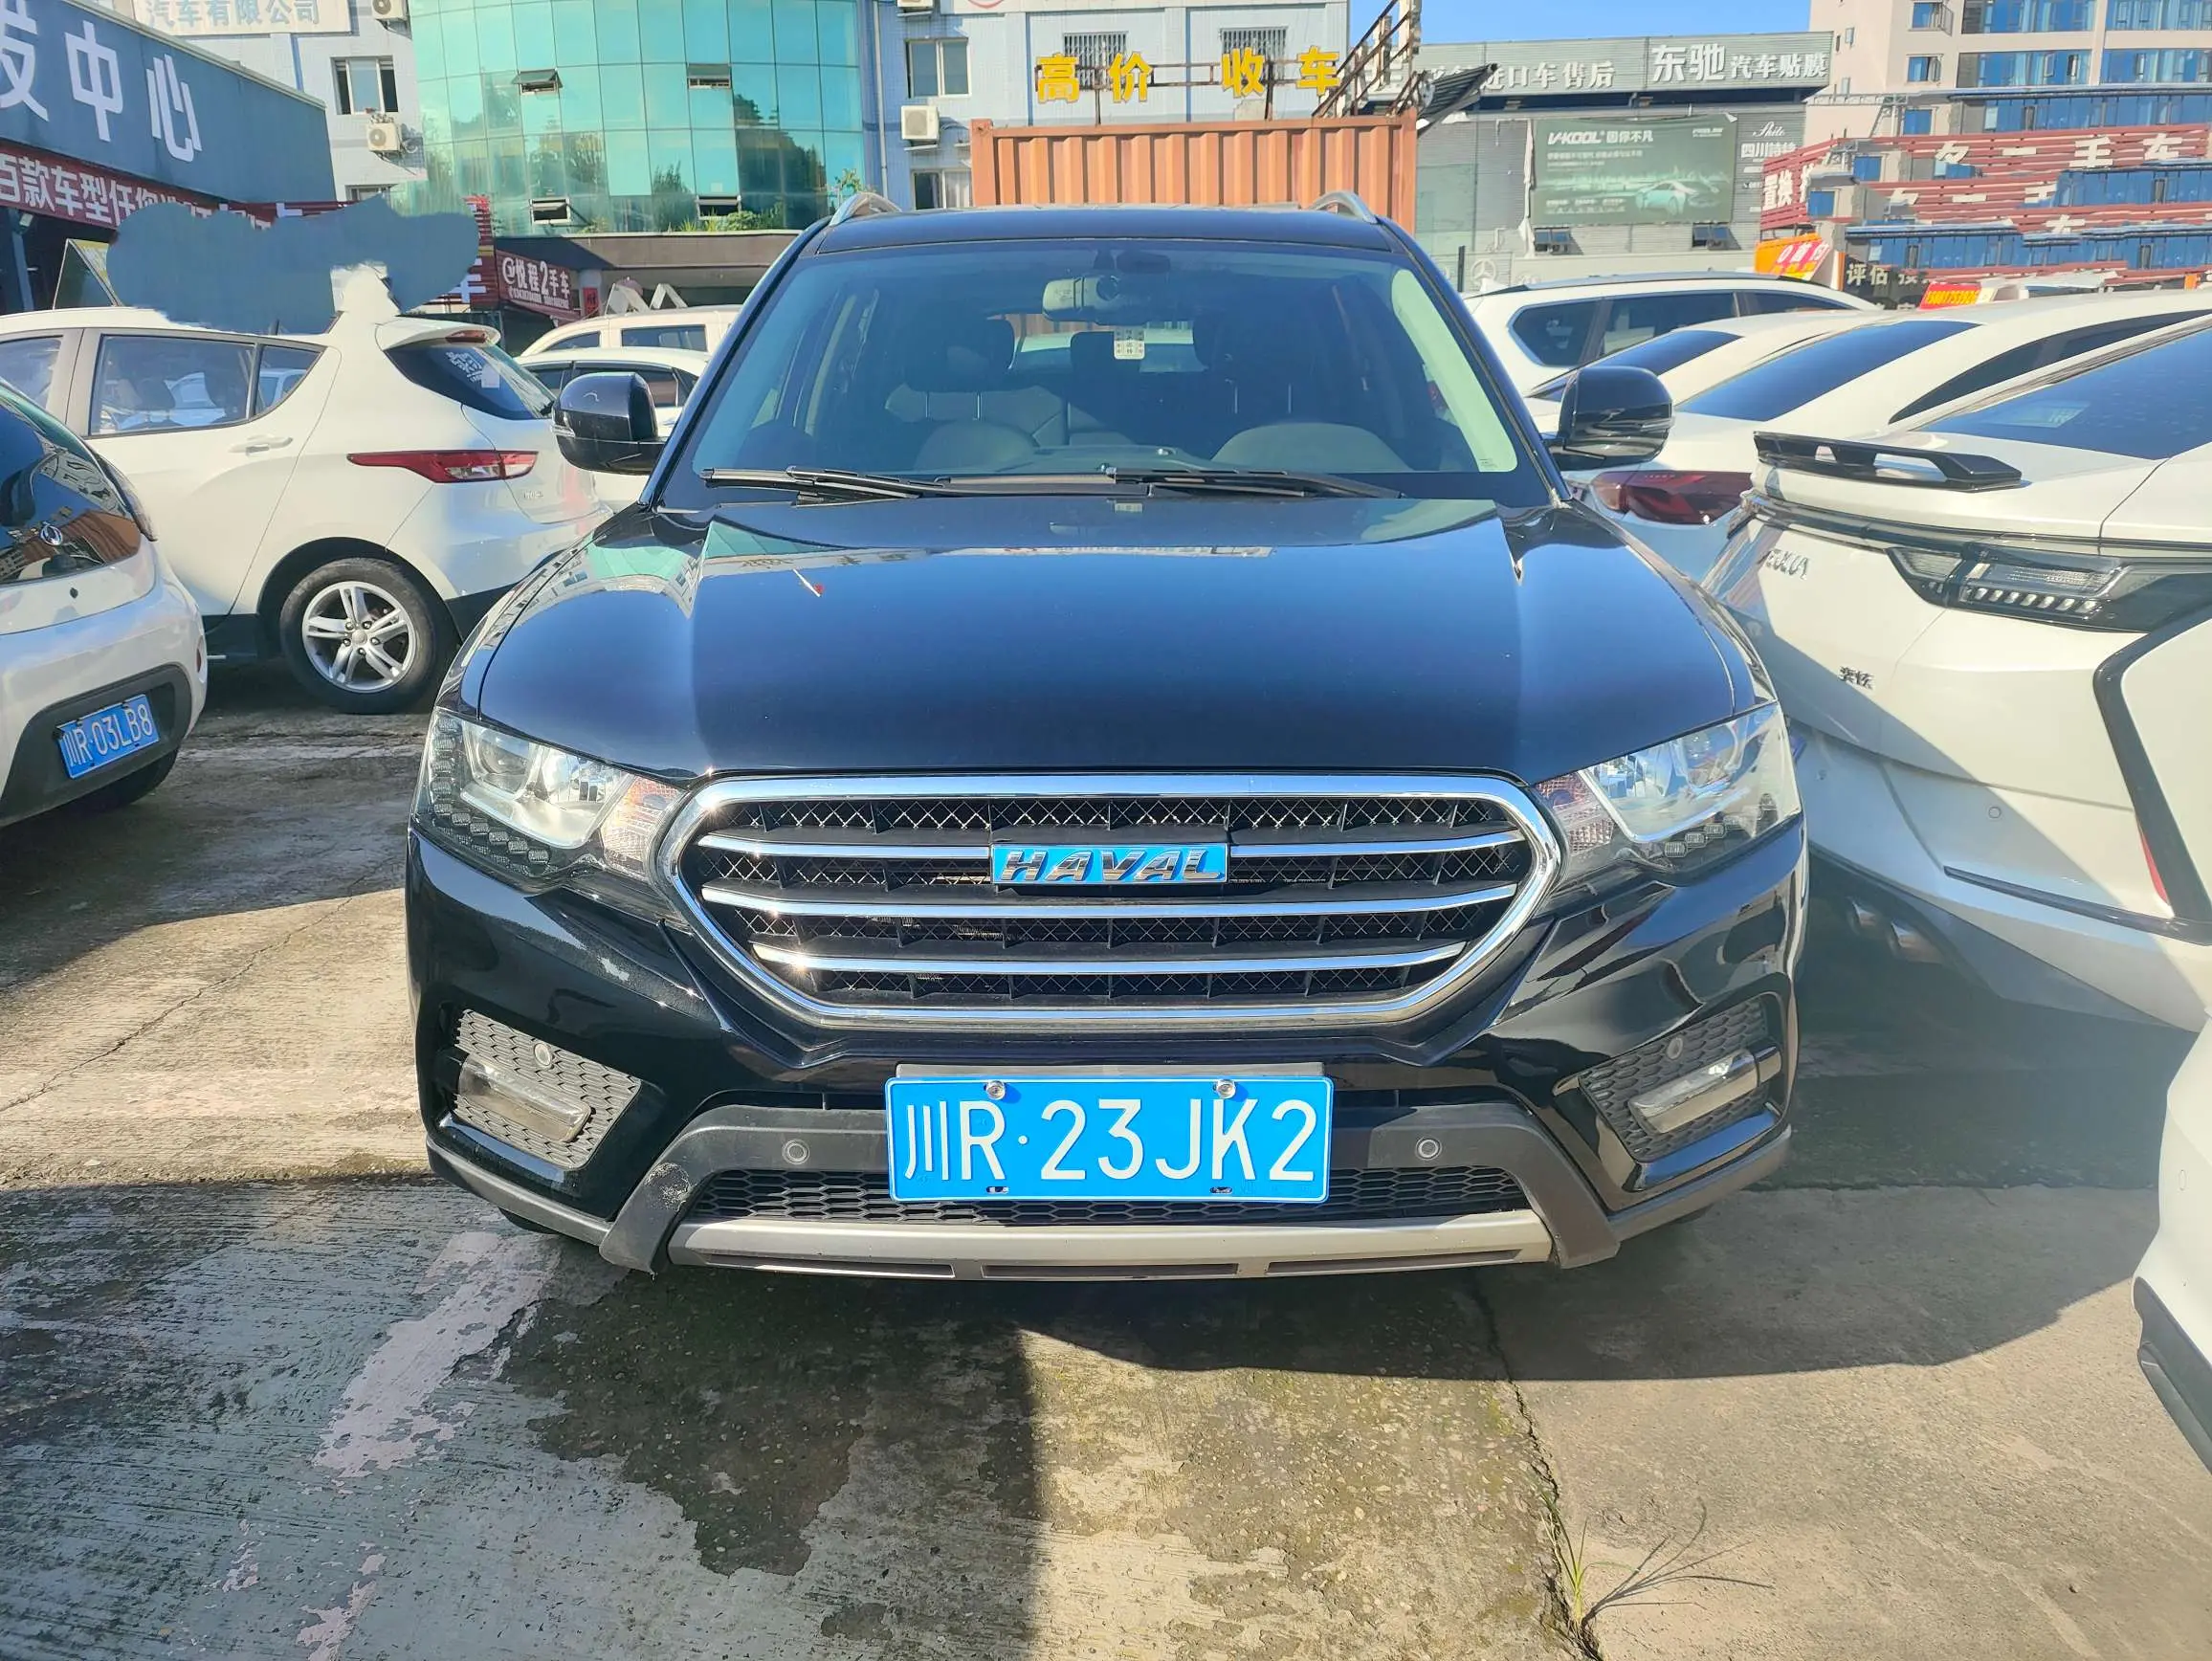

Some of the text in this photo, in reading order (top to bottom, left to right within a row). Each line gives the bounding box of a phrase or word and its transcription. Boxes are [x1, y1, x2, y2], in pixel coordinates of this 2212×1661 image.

[1036, 45, 1341, 103] 高价收车
[1650, 43, 1830, 82] 东驰 汽车贴膜
[1001, 849, 1226, 882] HAVAL
[904, 1097, 1318, 1182] 川R·23JK2
